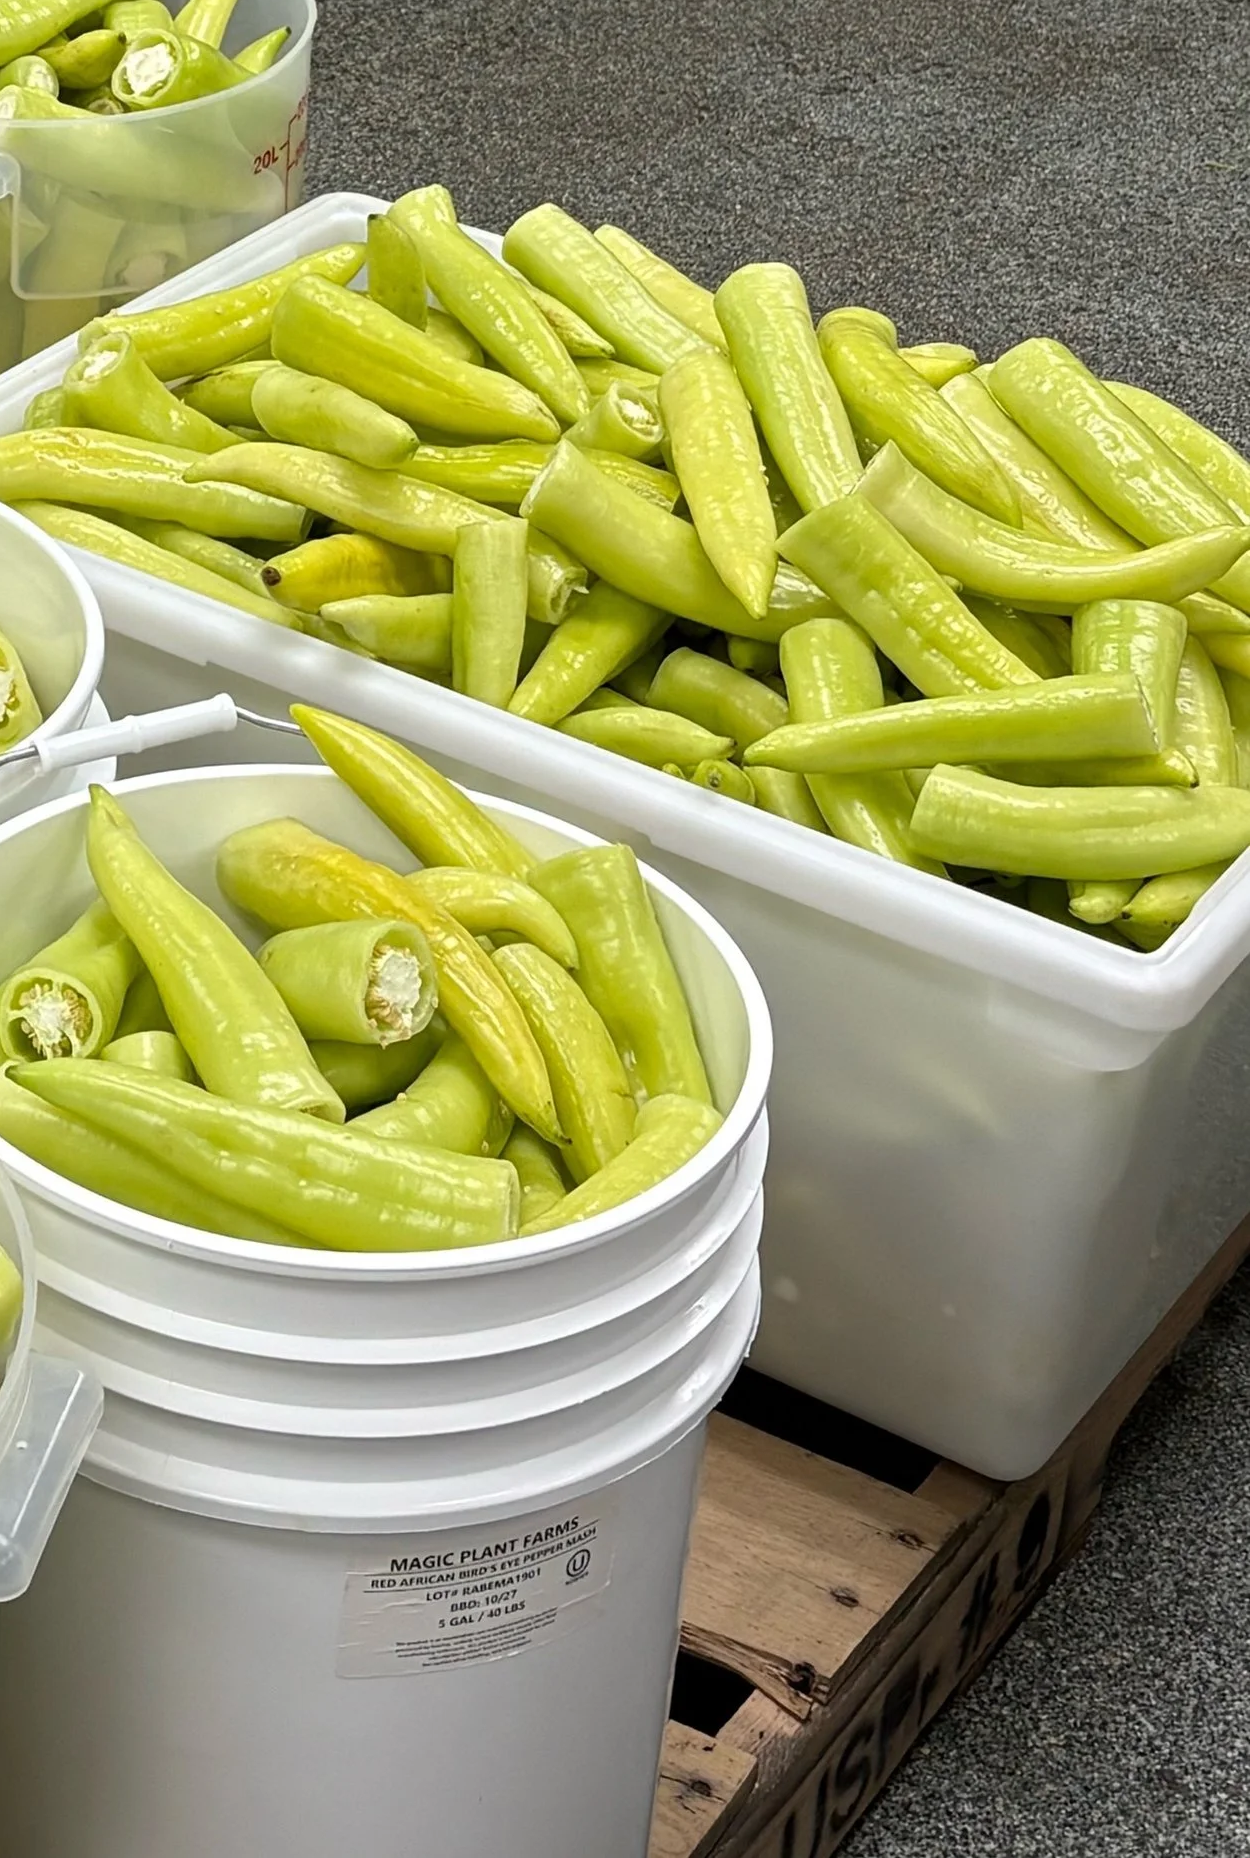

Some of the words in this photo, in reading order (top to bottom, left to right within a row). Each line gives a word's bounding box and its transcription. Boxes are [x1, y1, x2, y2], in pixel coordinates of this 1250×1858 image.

[254, 145, 279, 175] 20L
[371, 1579, 396, 1589] RED
[399, 1572, 455, 1587] AFRICAN
[500, 1556, 520, 1570] EYE
[523, 1541, 564, 1565] PEPPER
[565, 1526, 596, 1548] MASH
[390, 1552, 454, 1572] MAGIC
[460, 1538, 519, 1564] PLANT
[523, 1516, 579, 1548] FARMS
[426, 1589, 459, 1602] LOT#
[462, 1567, 541, 1596] RABEMA1901
[485, 1588, 518, 1607] 10/27
[438, 1618, 446, 1629] 5
[449, 1615, 475, 1627] GAL
[486, 1607, 502, 1619] 40
[504, 1599, 526, 1615] LBS
